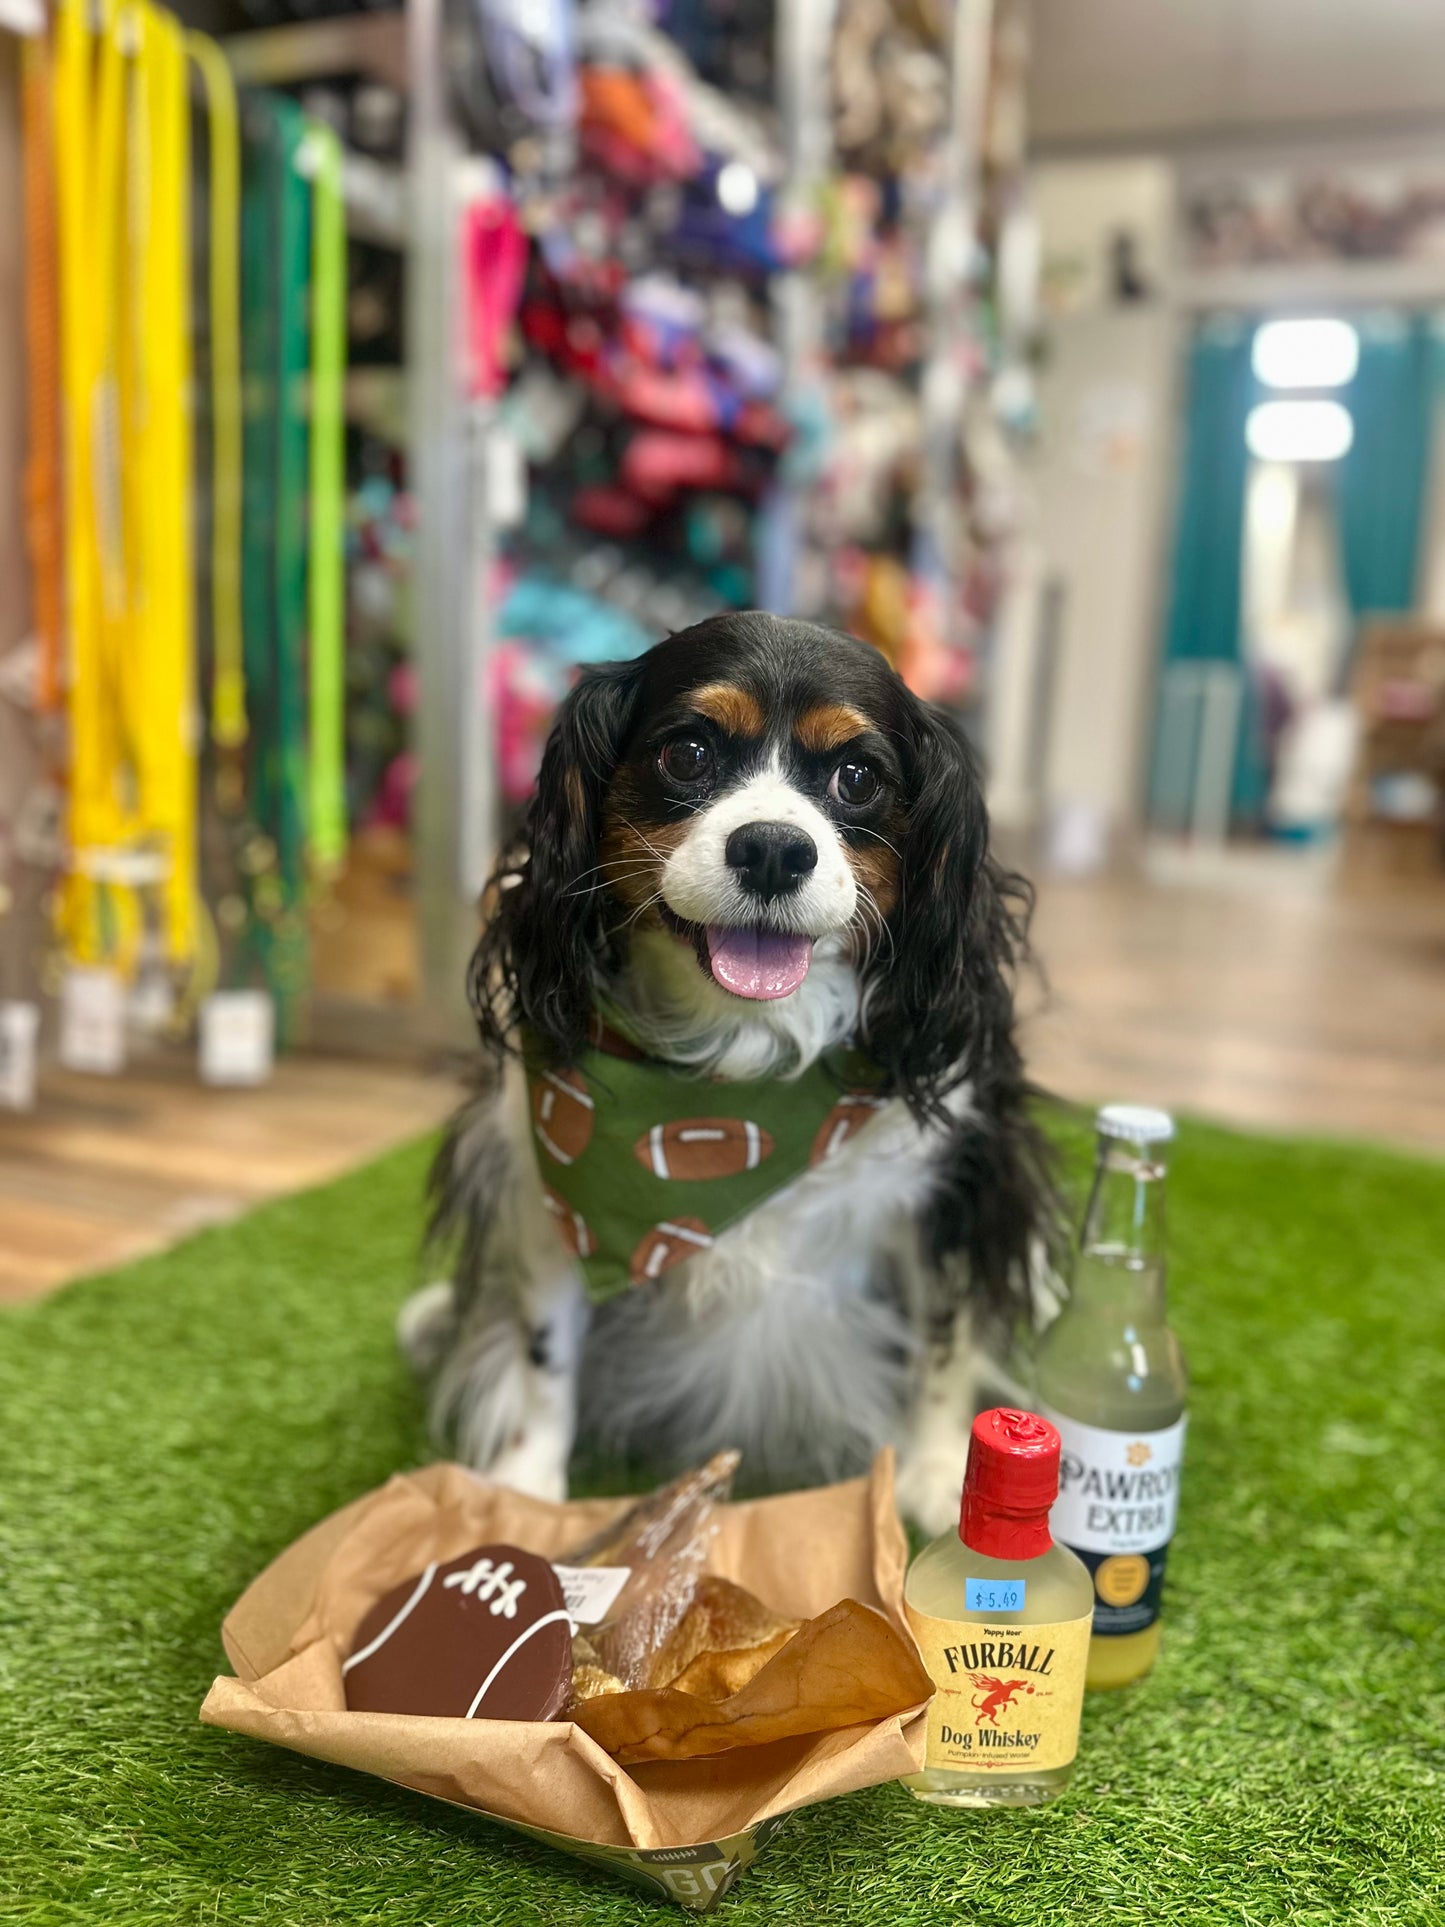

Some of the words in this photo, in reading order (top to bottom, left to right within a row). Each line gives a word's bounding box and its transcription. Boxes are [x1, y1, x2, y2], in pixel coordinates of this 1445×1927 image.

[1059, 1449, 1178, 1500] PAWRO
[1086, 1502, 1166, 1534] EXTRA
[983, 1628, 1004, 1638] Yappy
[943, 1642, 1056, 1676] FURBALL
[940, 1725, 973, 1750] Dog
[978, 1728, 1042, 1750] Whiskey
